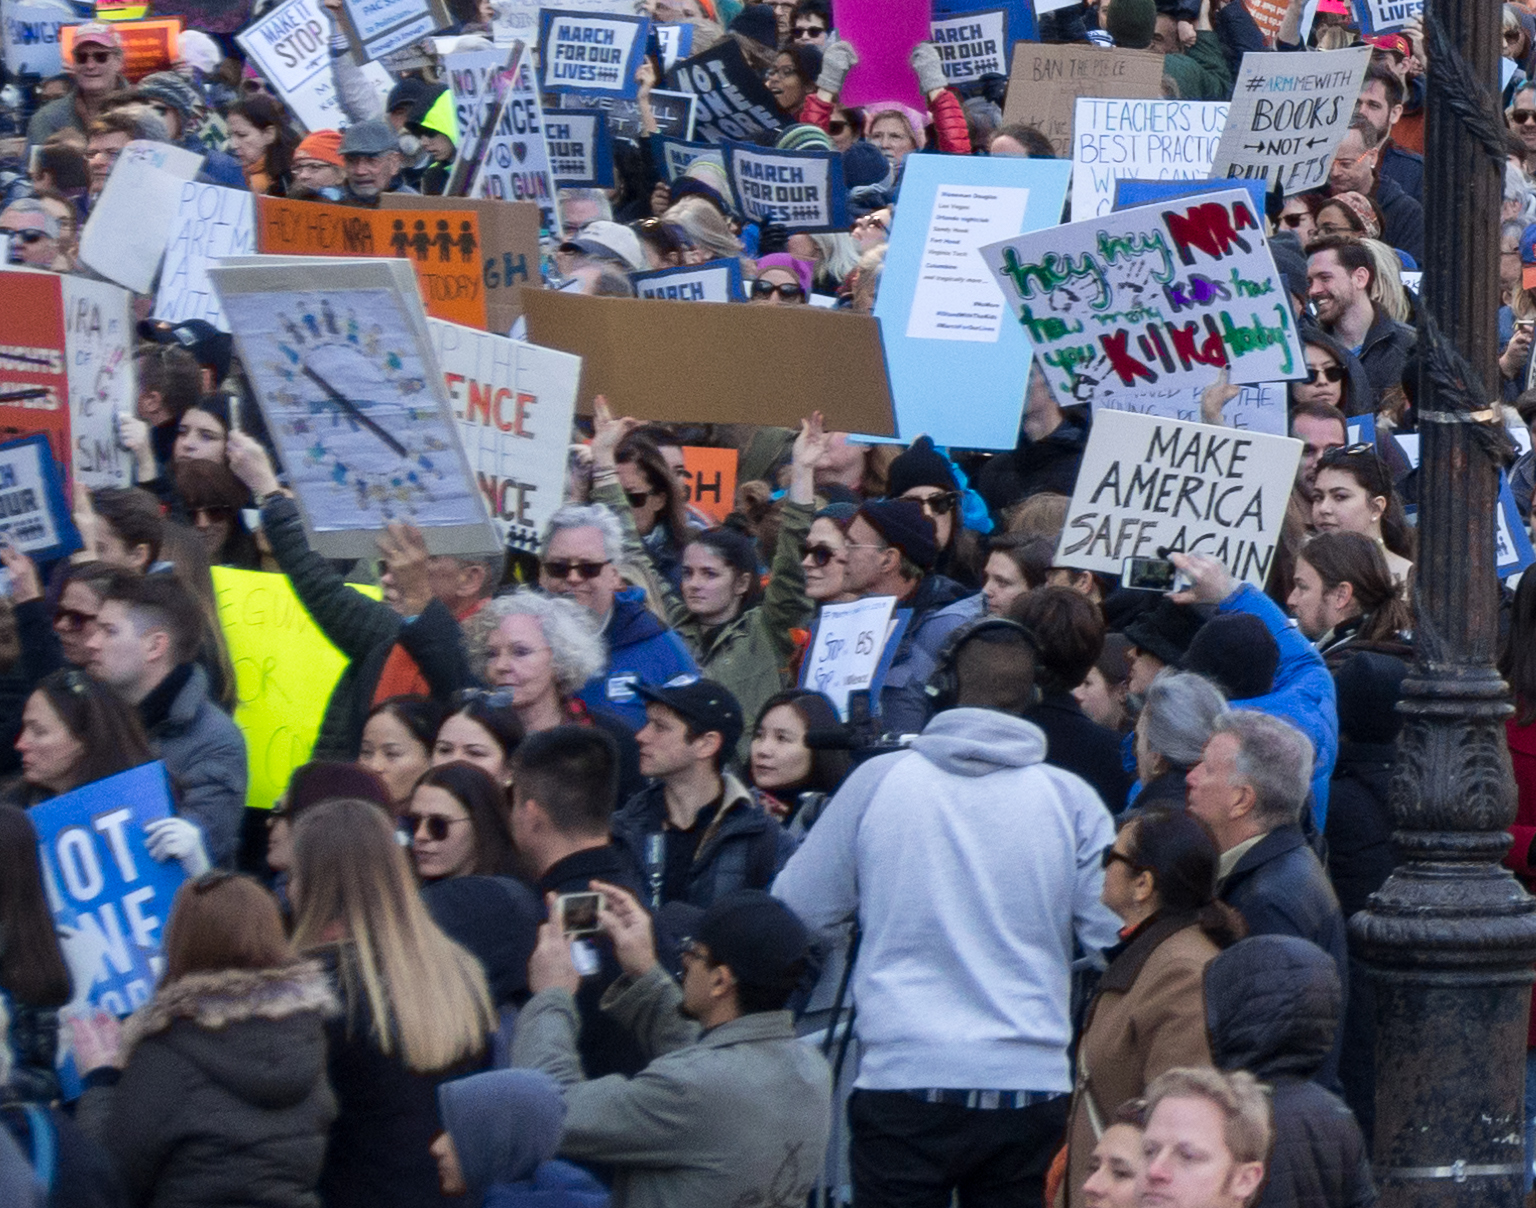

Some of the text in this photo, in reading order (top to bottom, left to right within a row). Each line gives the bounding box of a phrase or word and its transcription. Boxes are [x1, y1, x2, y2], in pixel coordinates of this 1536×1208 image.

[260, 7, 298, 46] MAKE
[556, 25, 615, 45] MARCH
[273, 18, 332, 70] STOP
[554, 44, 622, 65] FOR OUR
[553, 62, 596, 82] LIVES
[674, 56, 730, 94] NOT
[1033, 57, 1063, 82] BAN
[695, 85, 750, 125] ONE
[1091, 100, 1191, 132] TEACHERS
[1252, 95, 1345, 132] BOOKS
[1080, 133, 1137, 163] BEST
[1266, 137, 1301, 156] NOT
[739, 158, 804, 184] MARCH
[742, 177, 820, 203] FOR OUR
[1238, 386, 1275, 406] THE
[1146, 426, 1252, 479] MAKE
[1090, 461, 1265, 533] AMERICA
[1062, 512, 1158, 561] SAFE
